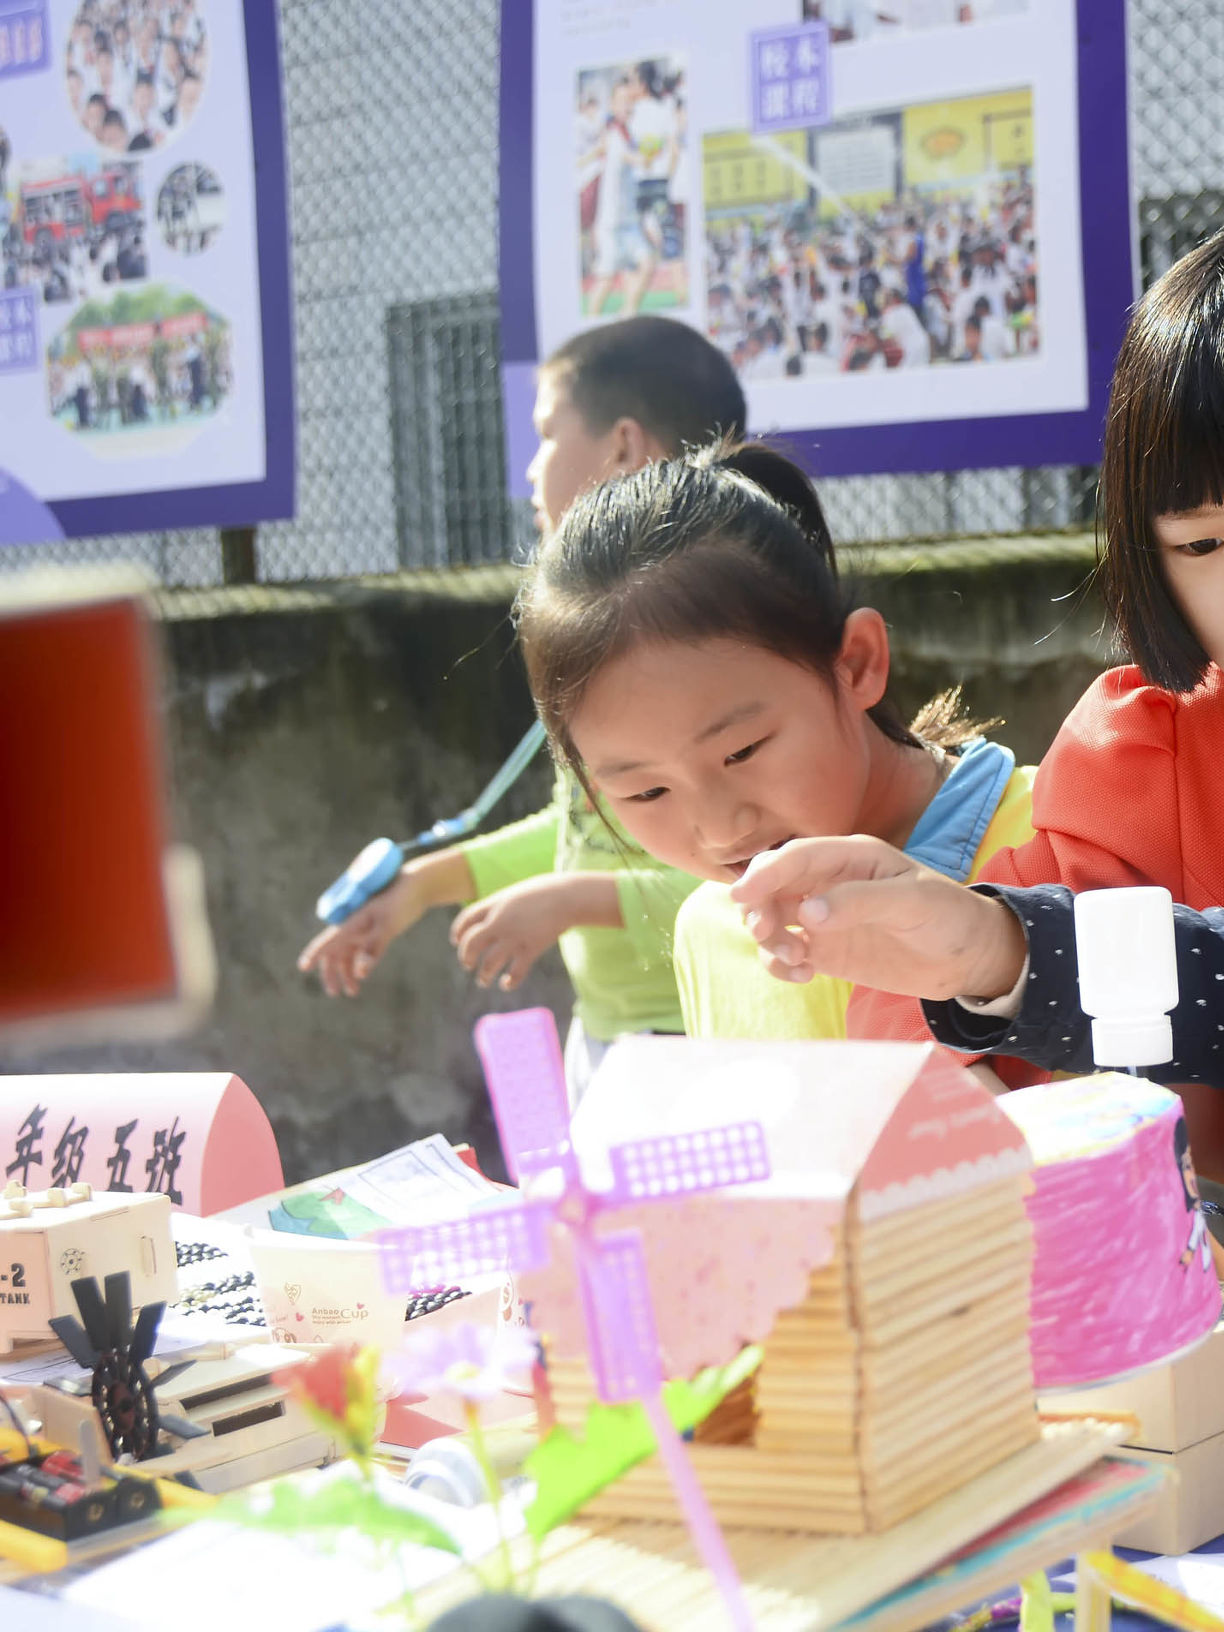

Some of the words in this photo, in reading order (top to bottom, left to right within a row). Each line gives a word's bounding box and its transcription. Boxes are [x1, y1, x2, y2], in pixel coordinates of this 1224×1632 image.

[5, 1103, 187, 1206] 年级五班
[0, 1292, 31, 1305] TANK
[340, 1308, 369, 1320] Cup
